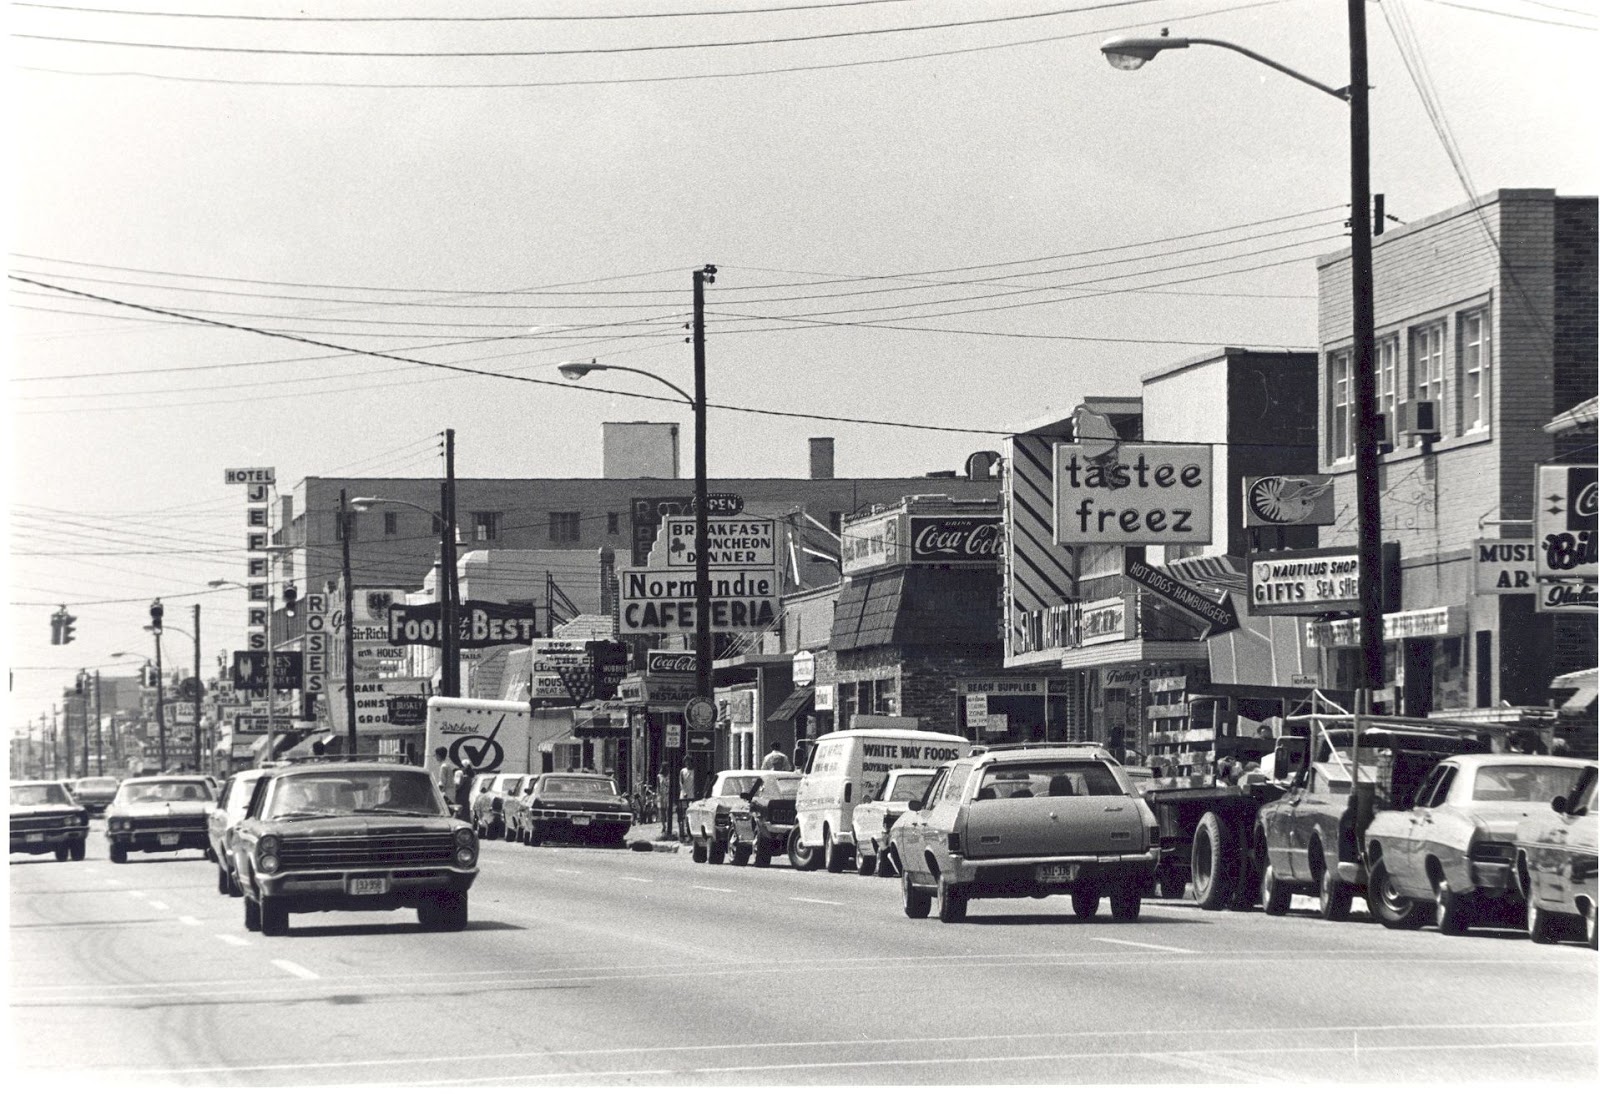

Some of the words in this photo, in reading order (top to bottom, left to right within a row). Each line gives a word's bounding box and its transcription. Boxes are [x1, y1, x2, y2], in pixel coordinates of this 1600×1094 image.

[228, 471, 272, 482] HOTEL
[1065, 453, 1202, 488] tastee
[707, 499, 737, 511] PEN
[1076, 497, 1192, 532] freez
[672, 524, 770, 535] BRAKFAST
[695, 538, 771, 549] UNCHEON
[687, 552, 756, 562] DNNER
[1130, 561, 1150, 577] HOT
[1273, 562, 1326, 577] NAUTILUS
[1330, 560, 1357, 574] SHOP
[630, 573, 769, 597] Normndie
[1496, 570, 1534, 587] AR
[1255, 583, 1305, 601] GIFTS
[1316, 579, 1335, 596] SEA
[1339, 577, 1359, 597] SHE
[625, 600, 774, 629] CAFEERIA
[391, 610, 442, 641] FOO
[472, 609, 534, 641] BEST
[308, 595, 324, 692] ROSES
[377, 648, 404, 658] HOUSE
[354, 684, 385, 692] RANK
[538, 678, 563, 687] HOUS
[967, 683, 994, 691] BEACH
[998, 683, 1037, 692] SUPPLIES
[357, 699, 385, 708] OHNS
[863, 743, 898, 758] WHITE
[900, 746, 922, 759] WAY
[924, 747, 960, 760] FOODS
